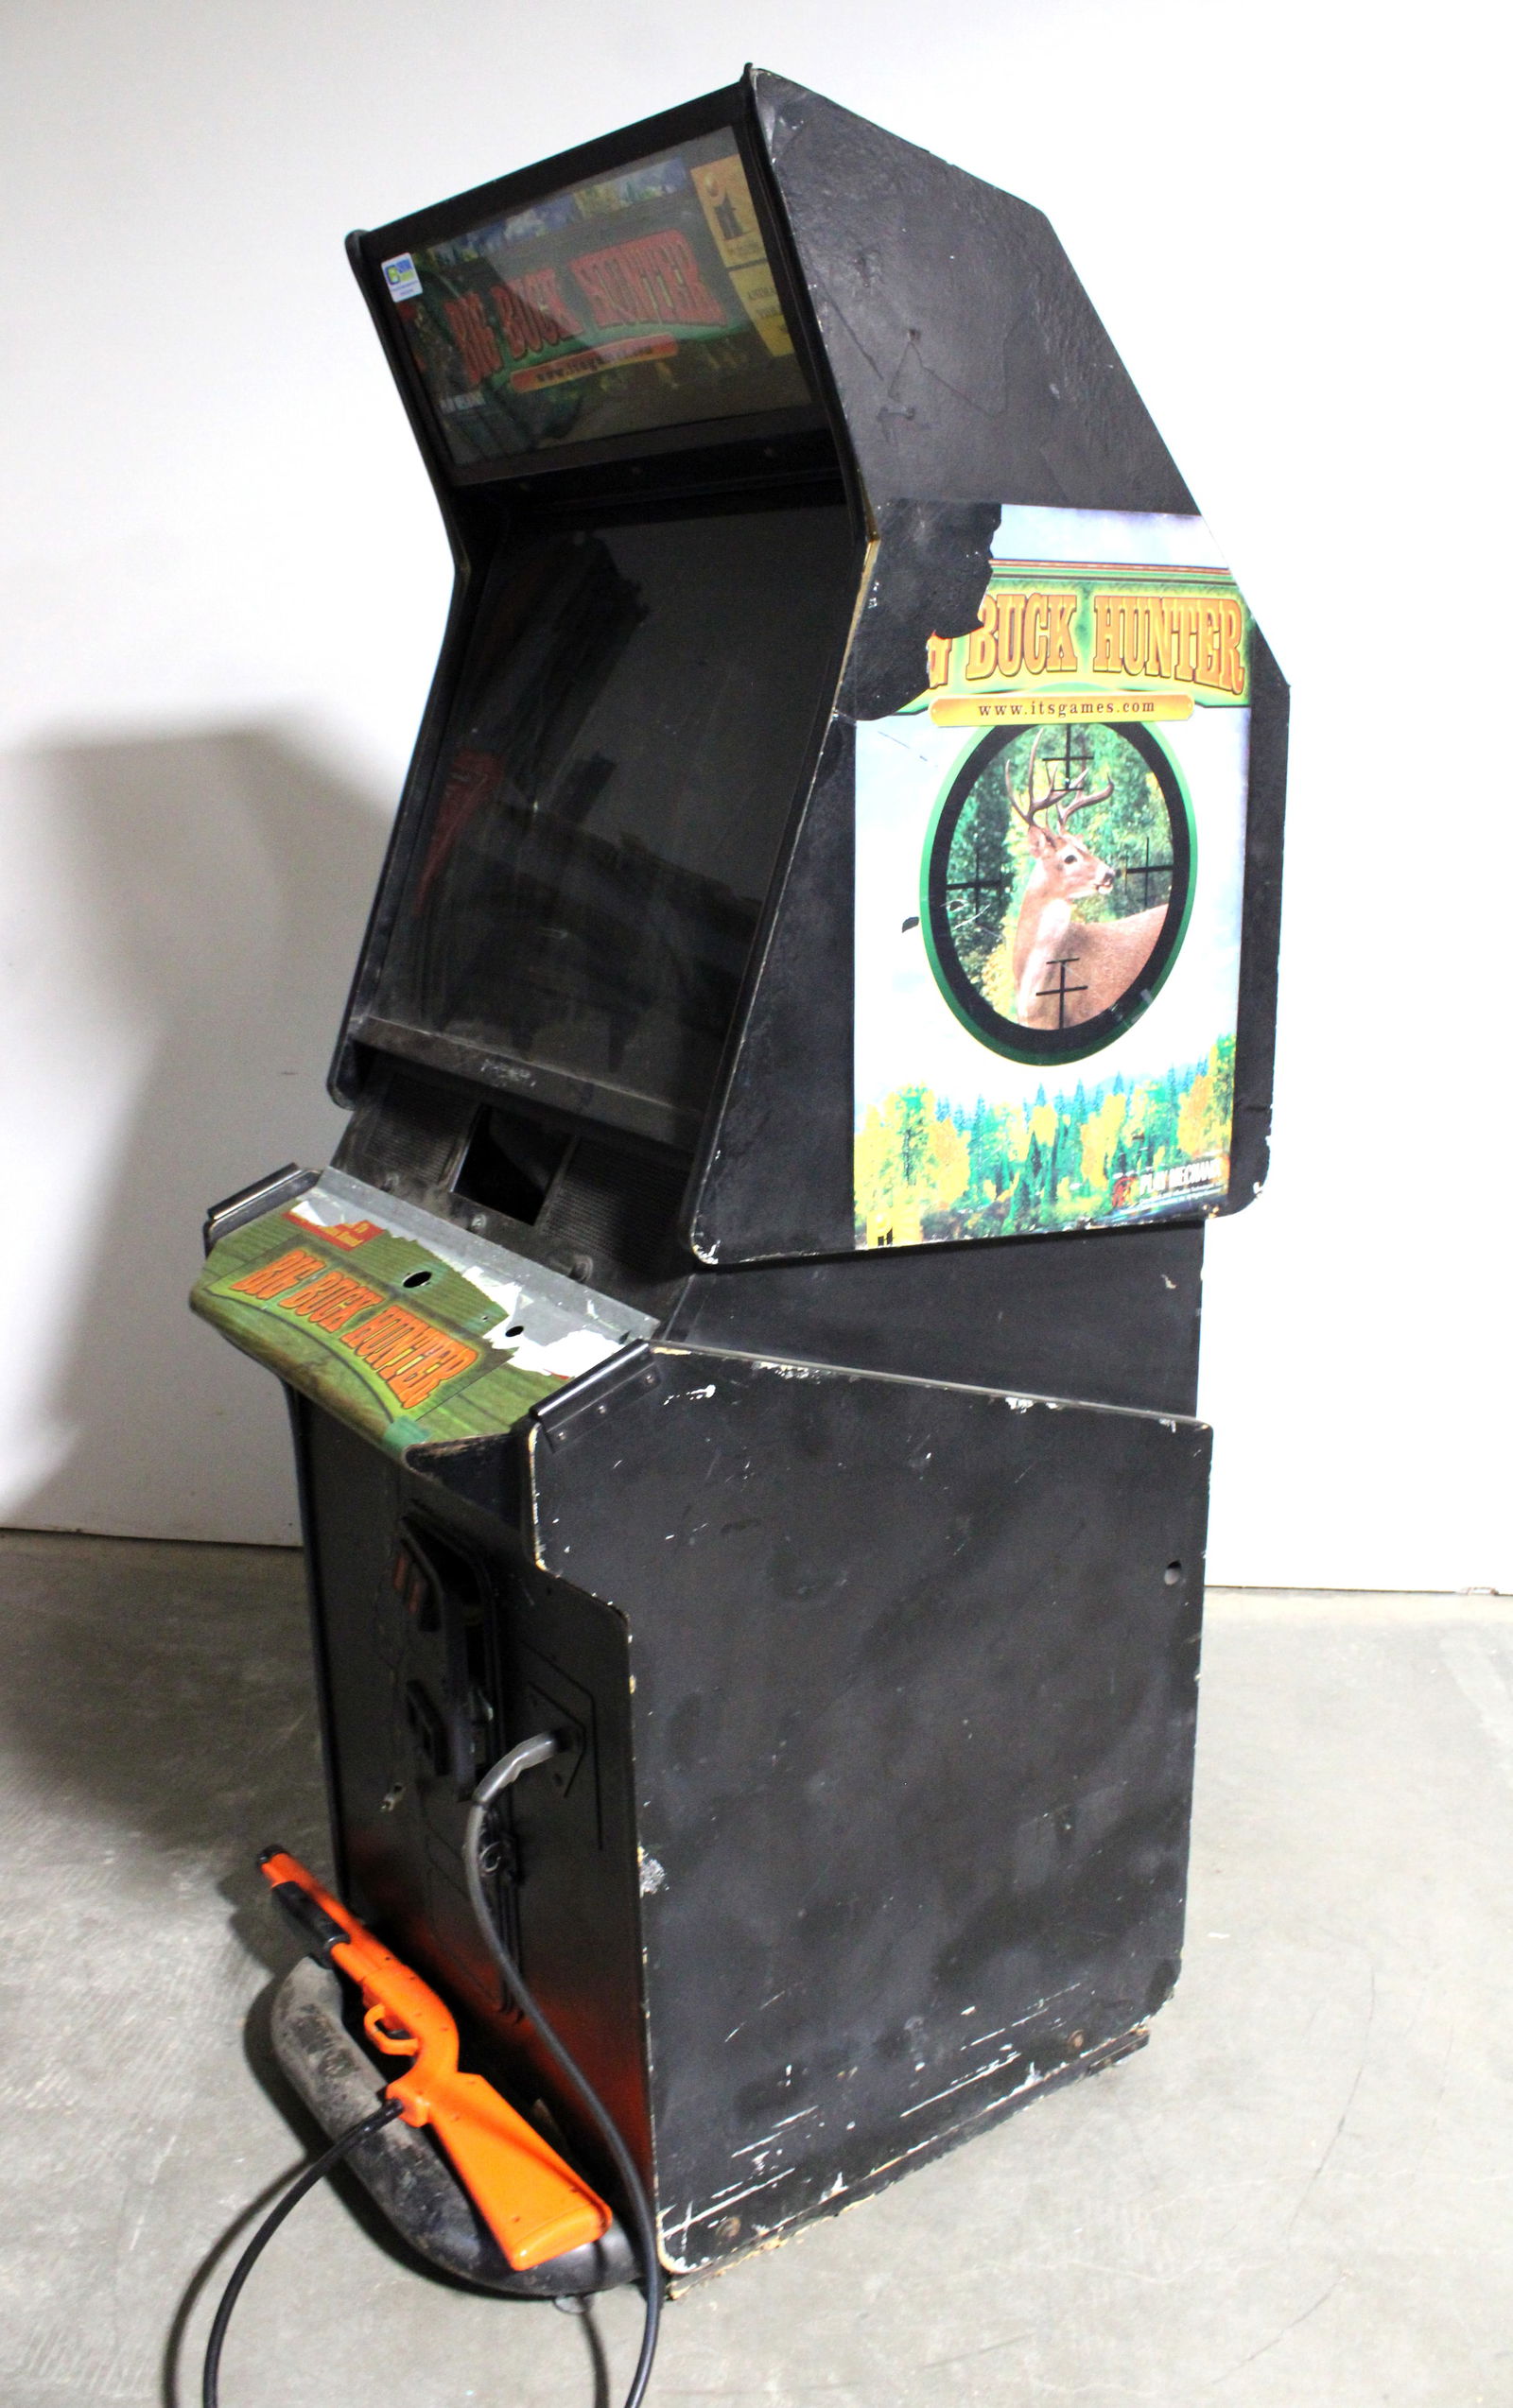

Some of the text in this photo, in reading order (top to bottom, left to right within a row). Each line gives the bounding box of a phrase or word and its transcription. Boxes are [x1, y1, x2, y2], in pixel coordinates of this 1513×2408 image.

[443, 229, 725, 385] BIG BUCK HUNTER
[965, 593, 1077, 680] BUCK
[1093, 595, 1245, 695] HUNTER
[978, 701, 1156, 719] www.itsgames.com
[229, 1249, 478, 1409] BIG BUCK HUNTER
